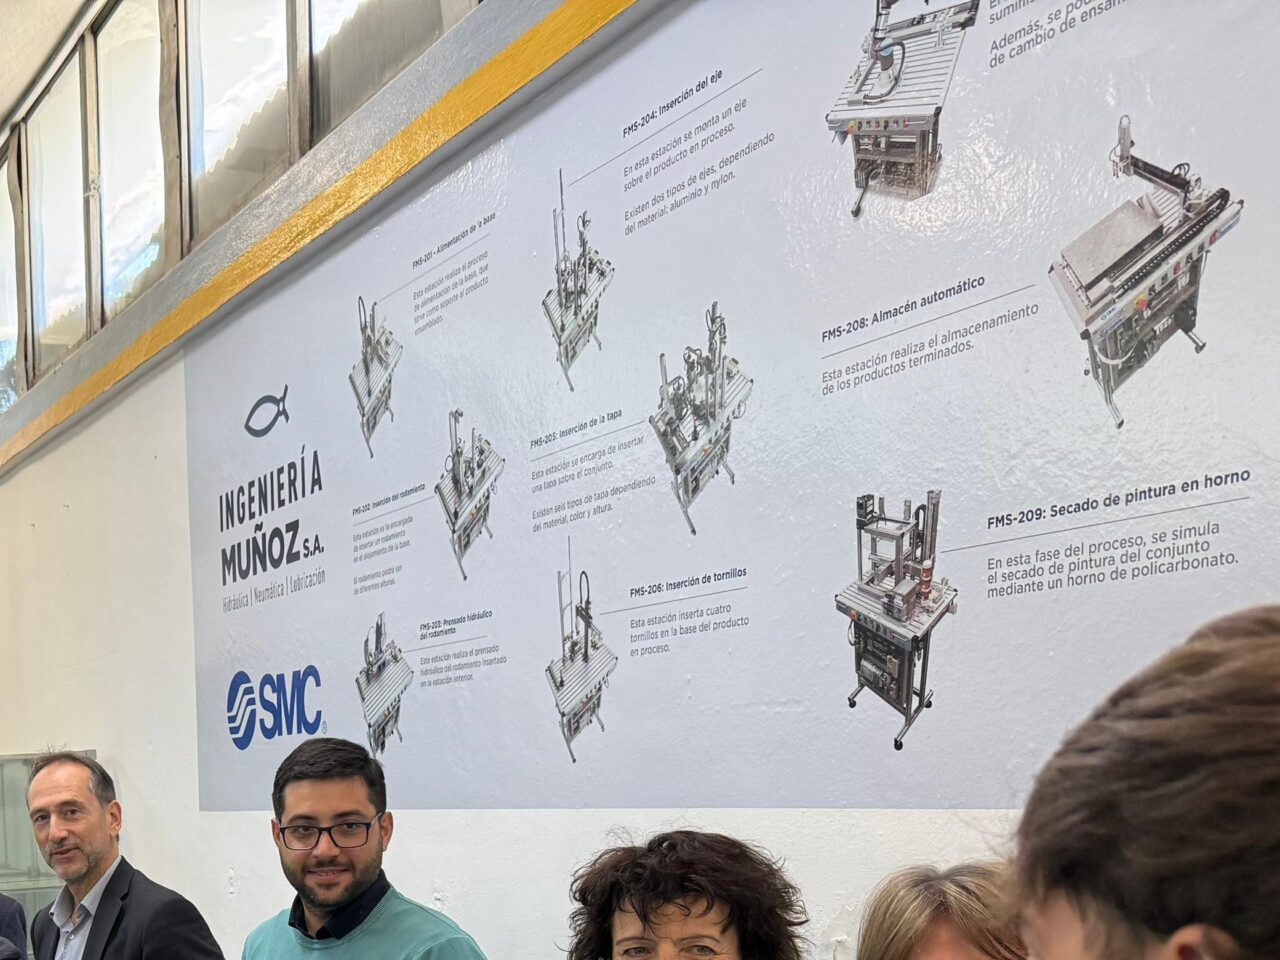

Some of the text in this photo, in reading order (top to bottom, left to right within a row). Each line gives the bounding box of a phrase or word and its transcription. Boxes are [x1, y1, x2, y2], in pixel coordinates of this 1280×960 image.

[990, 20, 1043, 54] Además,
[1047, 8, 1062, 24] se
[990, 54, 1005, 68] de
[1009, 27, 1055, 59] cambio
[1060, 18, 1076, 33] de
[623, 70, 722, 138] FMS-204: Inserción del eje
[624, 99, 746, 177] En esta estación se monta un eje
[624, 123, 735, 192] sobre el producto en proceso.
[625, 133, 774, 221] Existen dos tipos de ejes, dependiendo
[625, 171, 735, 236] del material: aluminio y nylon.
[822, 278, 985, 343] FMS-208: Almacén automático
[822, 306, 1039, 383] Esta estación realiza el almacenamiento
[822, 343, 974, 396] de los productos terminados.
[220, 444, 322, 532] INGENIERÍA
[988, 472, 1250, 530] FMS-209: Secado de pintura en horno
[221, 519, 300, 586] MUÑOZ
[303, 534, 324, 558] S.A.
[988, 524, 1220, 571] En esta fase del proceso, se simula
[988, 542, 1210, 584] el secado de pintura del conjunto
[255, 582, 284, 604] Neumática
[290, 567, 326, 593] Lubricación
[630, 568, 747, 598] FMS-206: Inserción de tornillos
[988, 555, 1238, 599] mediante un horno de policarbonato.
[630, 604, 731, 629] Esta estación inserta cuatro
[630, 617, 750, 643] tornillos en la base del producto
[630, 644, 670, 657] en proceso.
[259, 665, 322, 739] SMC
